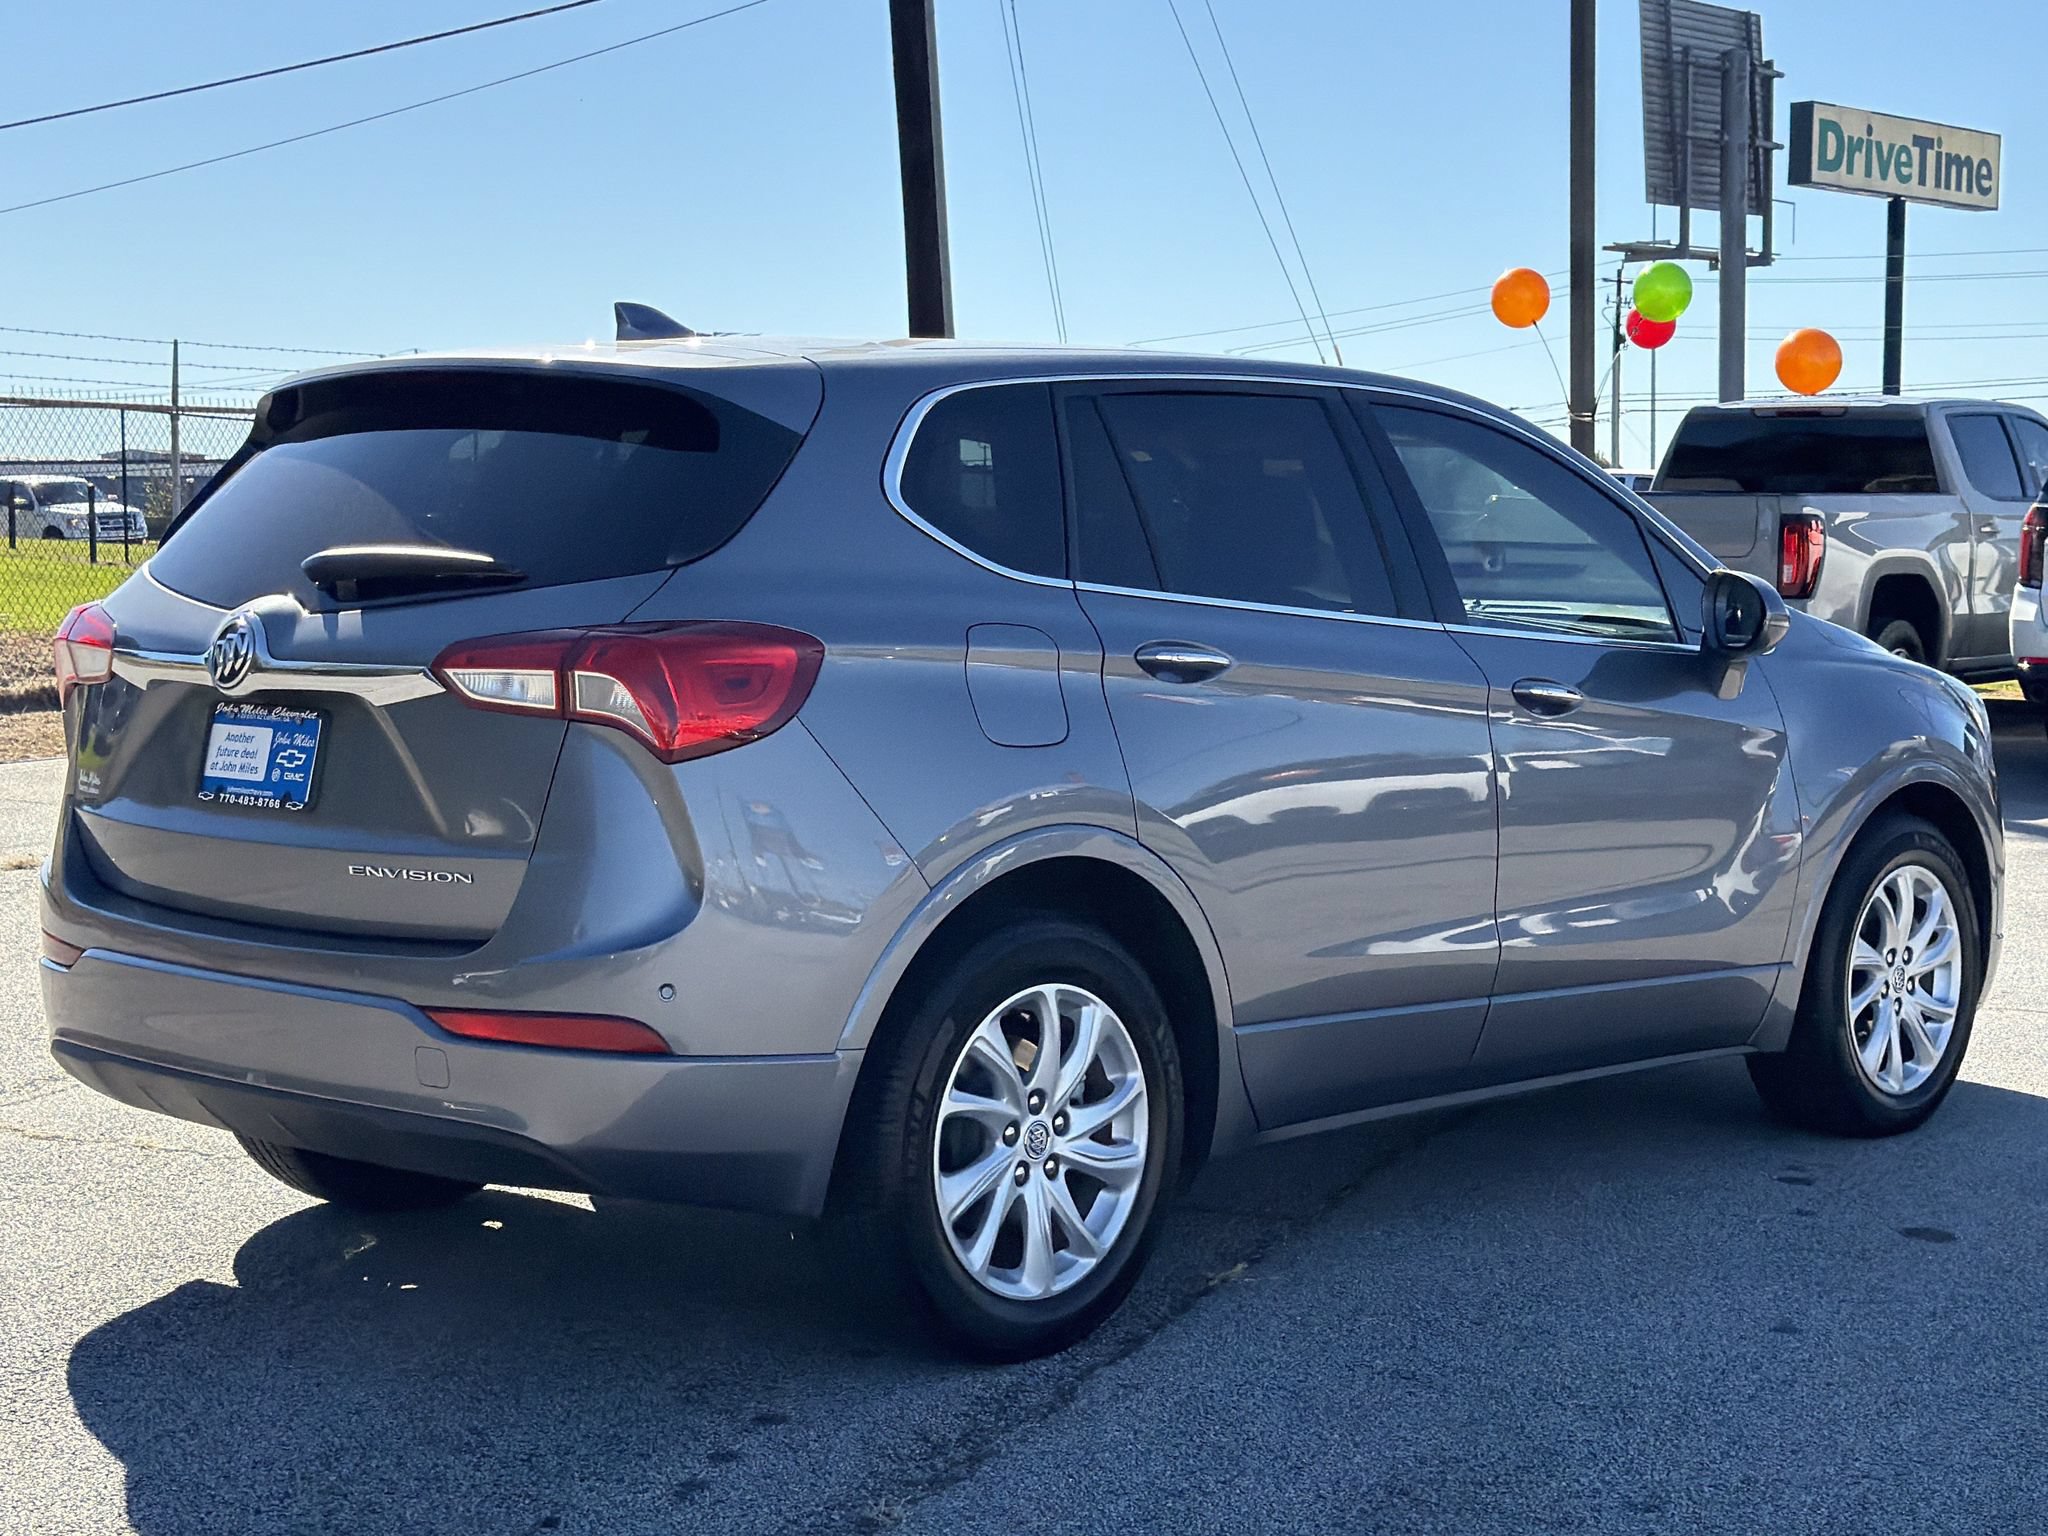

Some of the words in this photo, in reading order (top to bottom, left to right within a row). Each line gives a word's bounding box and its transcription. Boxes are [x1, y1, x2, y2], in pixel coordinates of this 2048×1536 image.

[1817, 117, 1993, 198] DriveTime
[215, 702, 239, 715] John
[239, 703, 268, 716] Miles
[271, 706, 318, 720] Chevrolet
[224, 731, 256, 744] Another
[272, 731, 291, 749] John
[292, 732, 315, 748] Miles
[215, 744, 239, 758] future
[240, 747, 258, 760] deal
[210, 761, 219, 771] at
[219, 760, 237, 772] John
[238, 762, 259, 775] Miles
[218, 793, 281, 809] 770-483-8766
[347, 864, 475, 885] ENVISION
